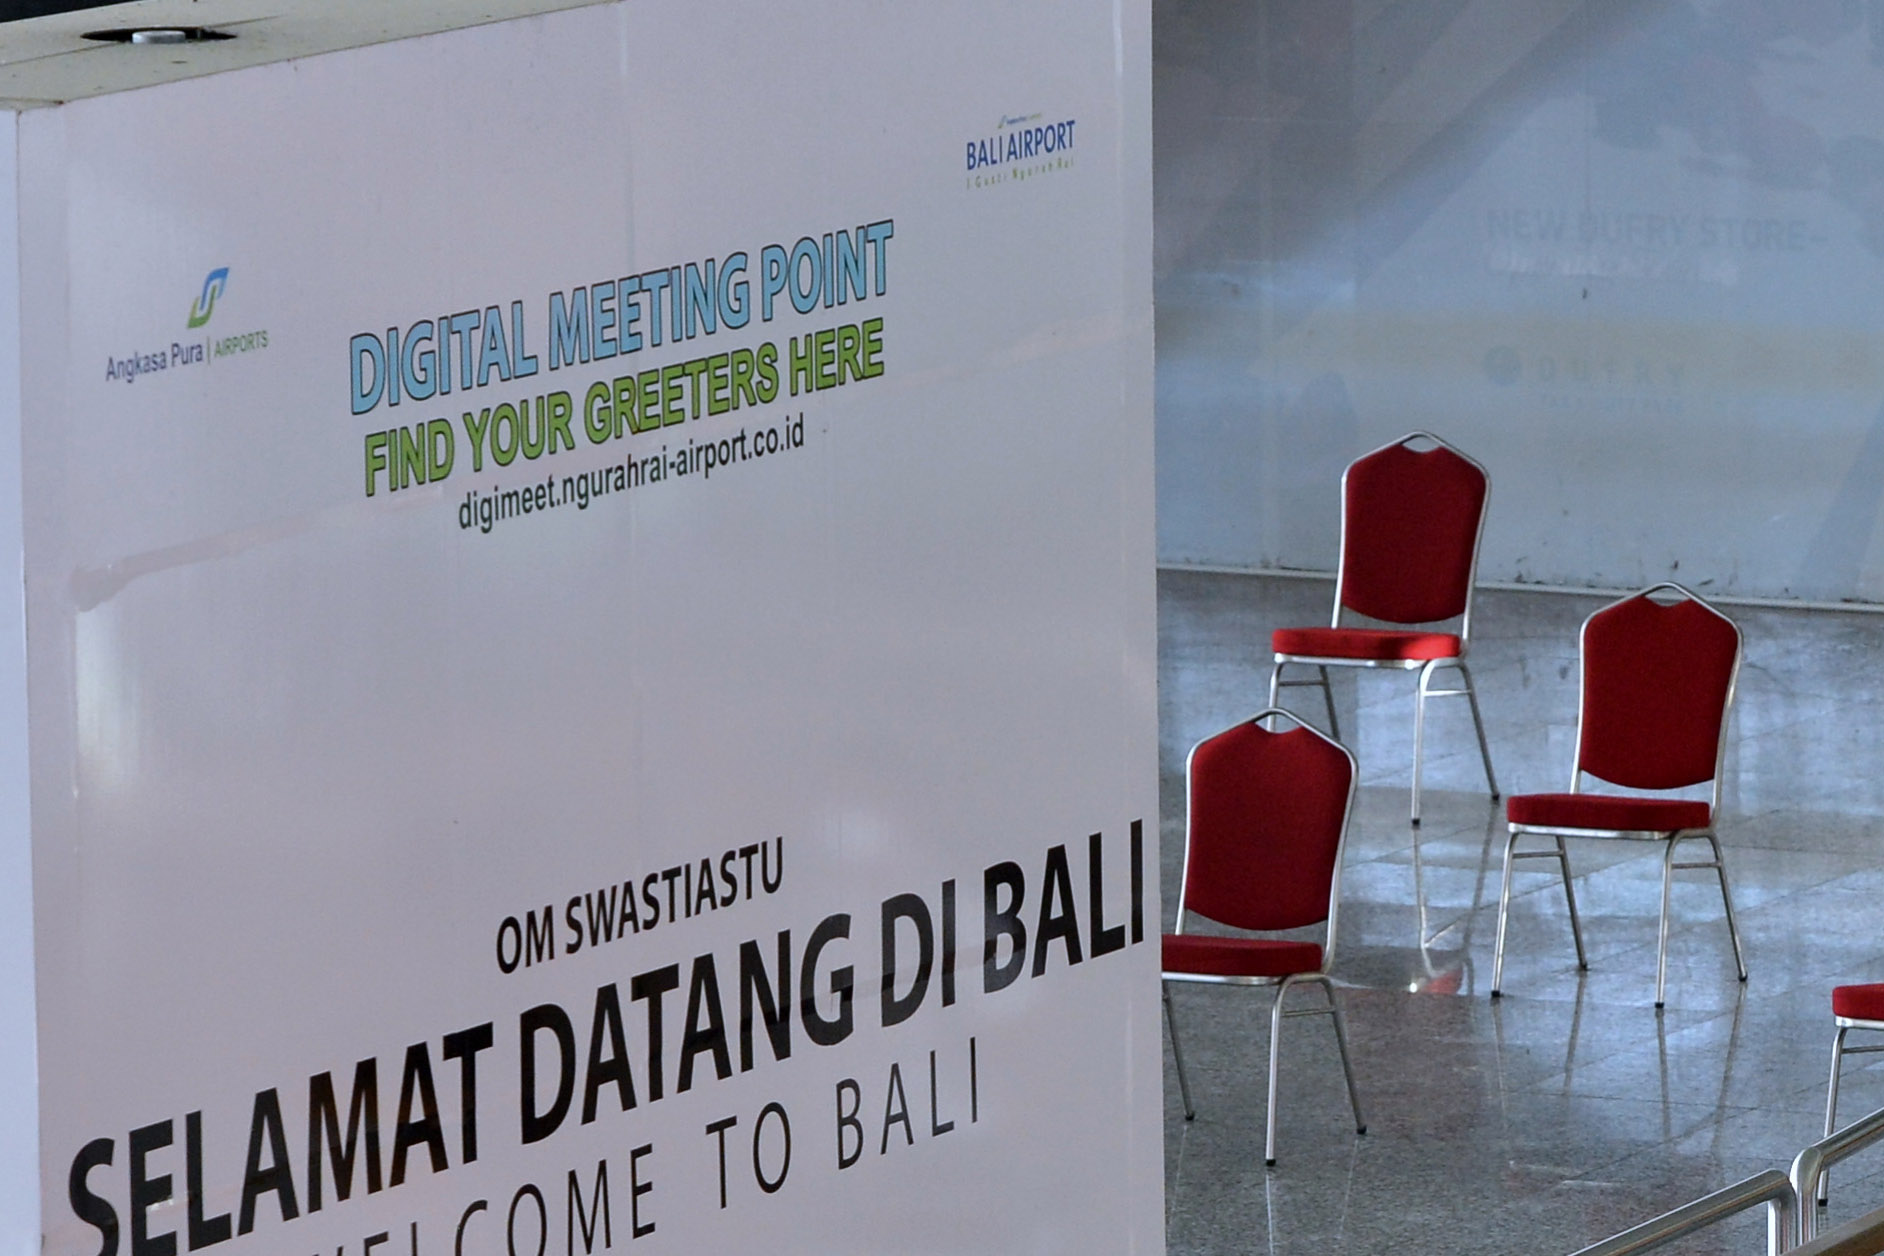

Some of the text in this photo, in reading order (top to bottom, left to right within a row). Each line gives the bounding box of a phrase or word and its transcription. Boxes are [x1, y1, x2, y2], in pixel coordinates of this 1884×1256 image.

[966, 119, 1076, 171] BALI AIRPORT
[105, 329, 270, 384] Angkasa Pura AIRPORTS
[350, 219, 894, 415] DIGITAL MEETING POINT
[365, 318, 885, 497] FIND YOUR GREETERS HERE
[458, 412, 805, 534] digimeet.ngurahrai-airport.co.id
[495, 836, 785, 975] OM SWASTIASTU
[518, 912, 854, 1146] DATANG
[878, 878, 957, 1031] DI
[981, 818, 1146, 998] BALI
[704, 1100, 792, 1210] TO
[834, 1036, 982, 1170] BALI
